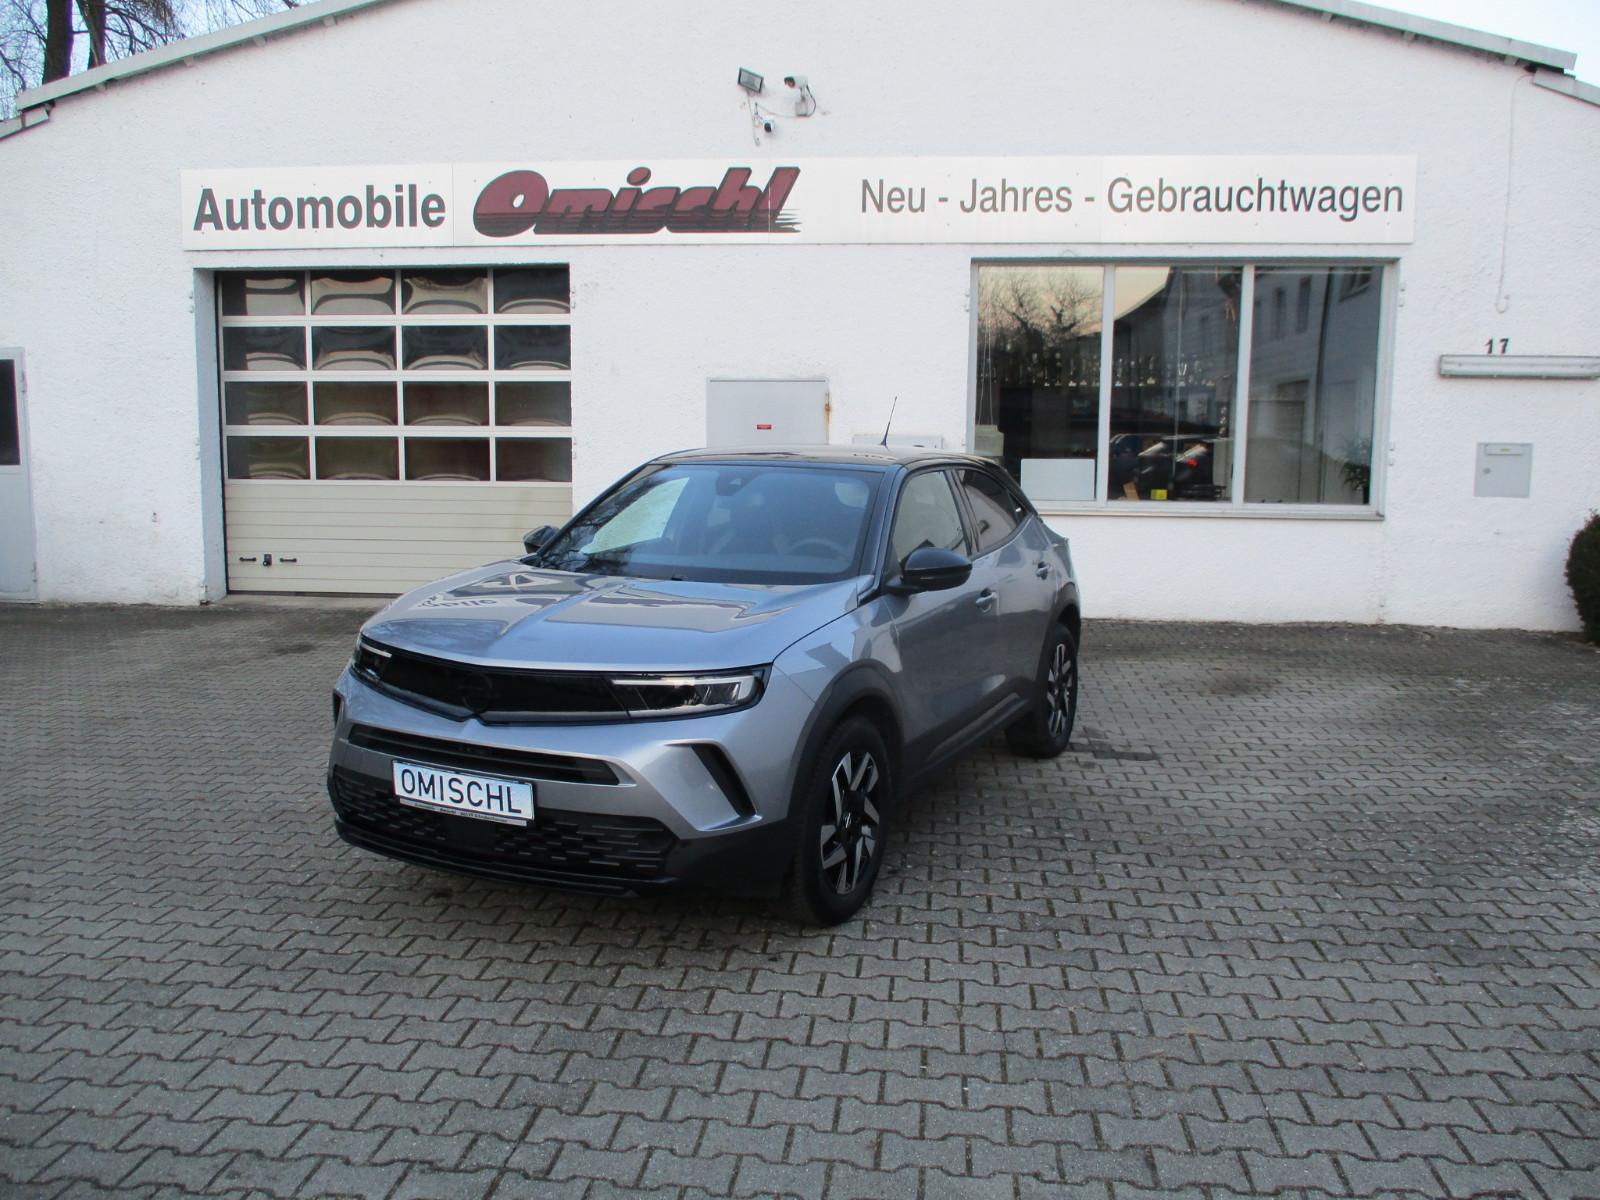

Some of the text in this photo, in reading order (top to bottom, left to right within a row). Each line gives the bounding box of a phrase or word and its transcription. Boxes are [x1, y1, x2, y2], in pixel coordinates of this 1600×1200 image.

[193, 184, 446, 231] Automobile
[473, 167, 802, 237] Omischl
[861, 178, 926, 213] Neu
[959, 178, 1073, 213] Jahres
[1107, 177, 1403, 222] Gebrauchtwagen
[1485, 338, 1509, 354] 17
[401, 769, 522, 814] OMISCHL
